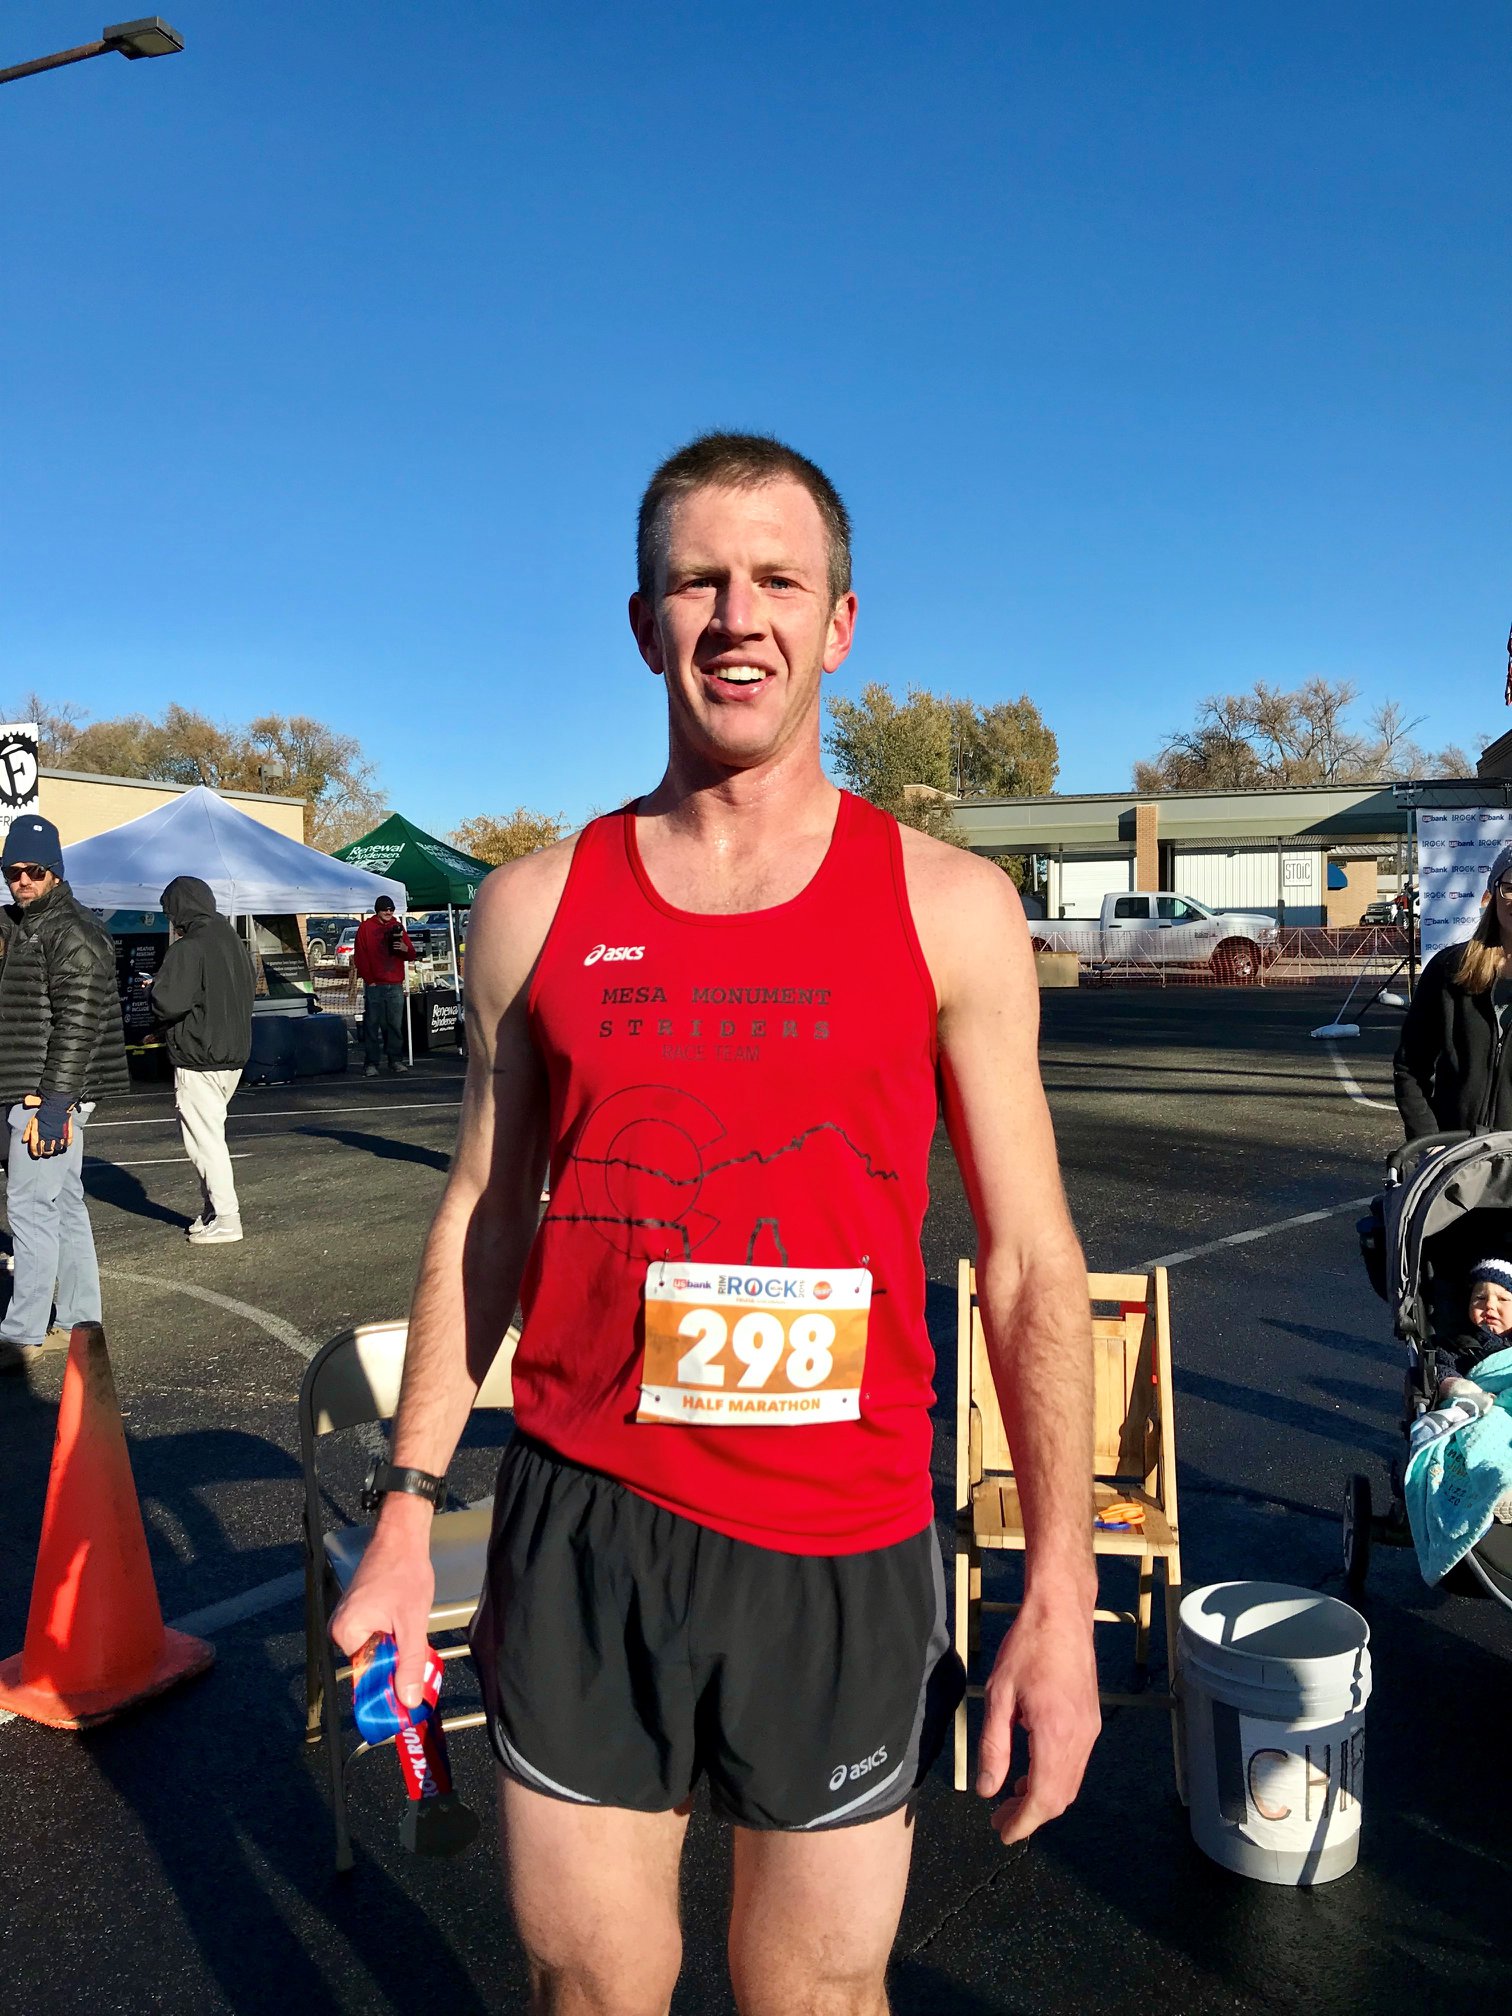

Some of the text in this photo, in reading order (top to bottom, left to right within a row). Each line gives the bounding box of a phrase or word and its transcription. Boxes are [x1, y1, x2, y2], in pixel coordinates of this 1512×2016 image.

[350, 842, 406, 856] Renewal
[601, 986, 832, 1005] MESA MONUMENT
[599, 1019, 830, 1040] STRIDERS
[662, 1044, 761, 1062] RACE TEAM
[727, 1276, 798, 1298] ROCK
[677, 1308, 836, 1389] 298
[682, 1395, 821, 1413] HALF MARATHON
